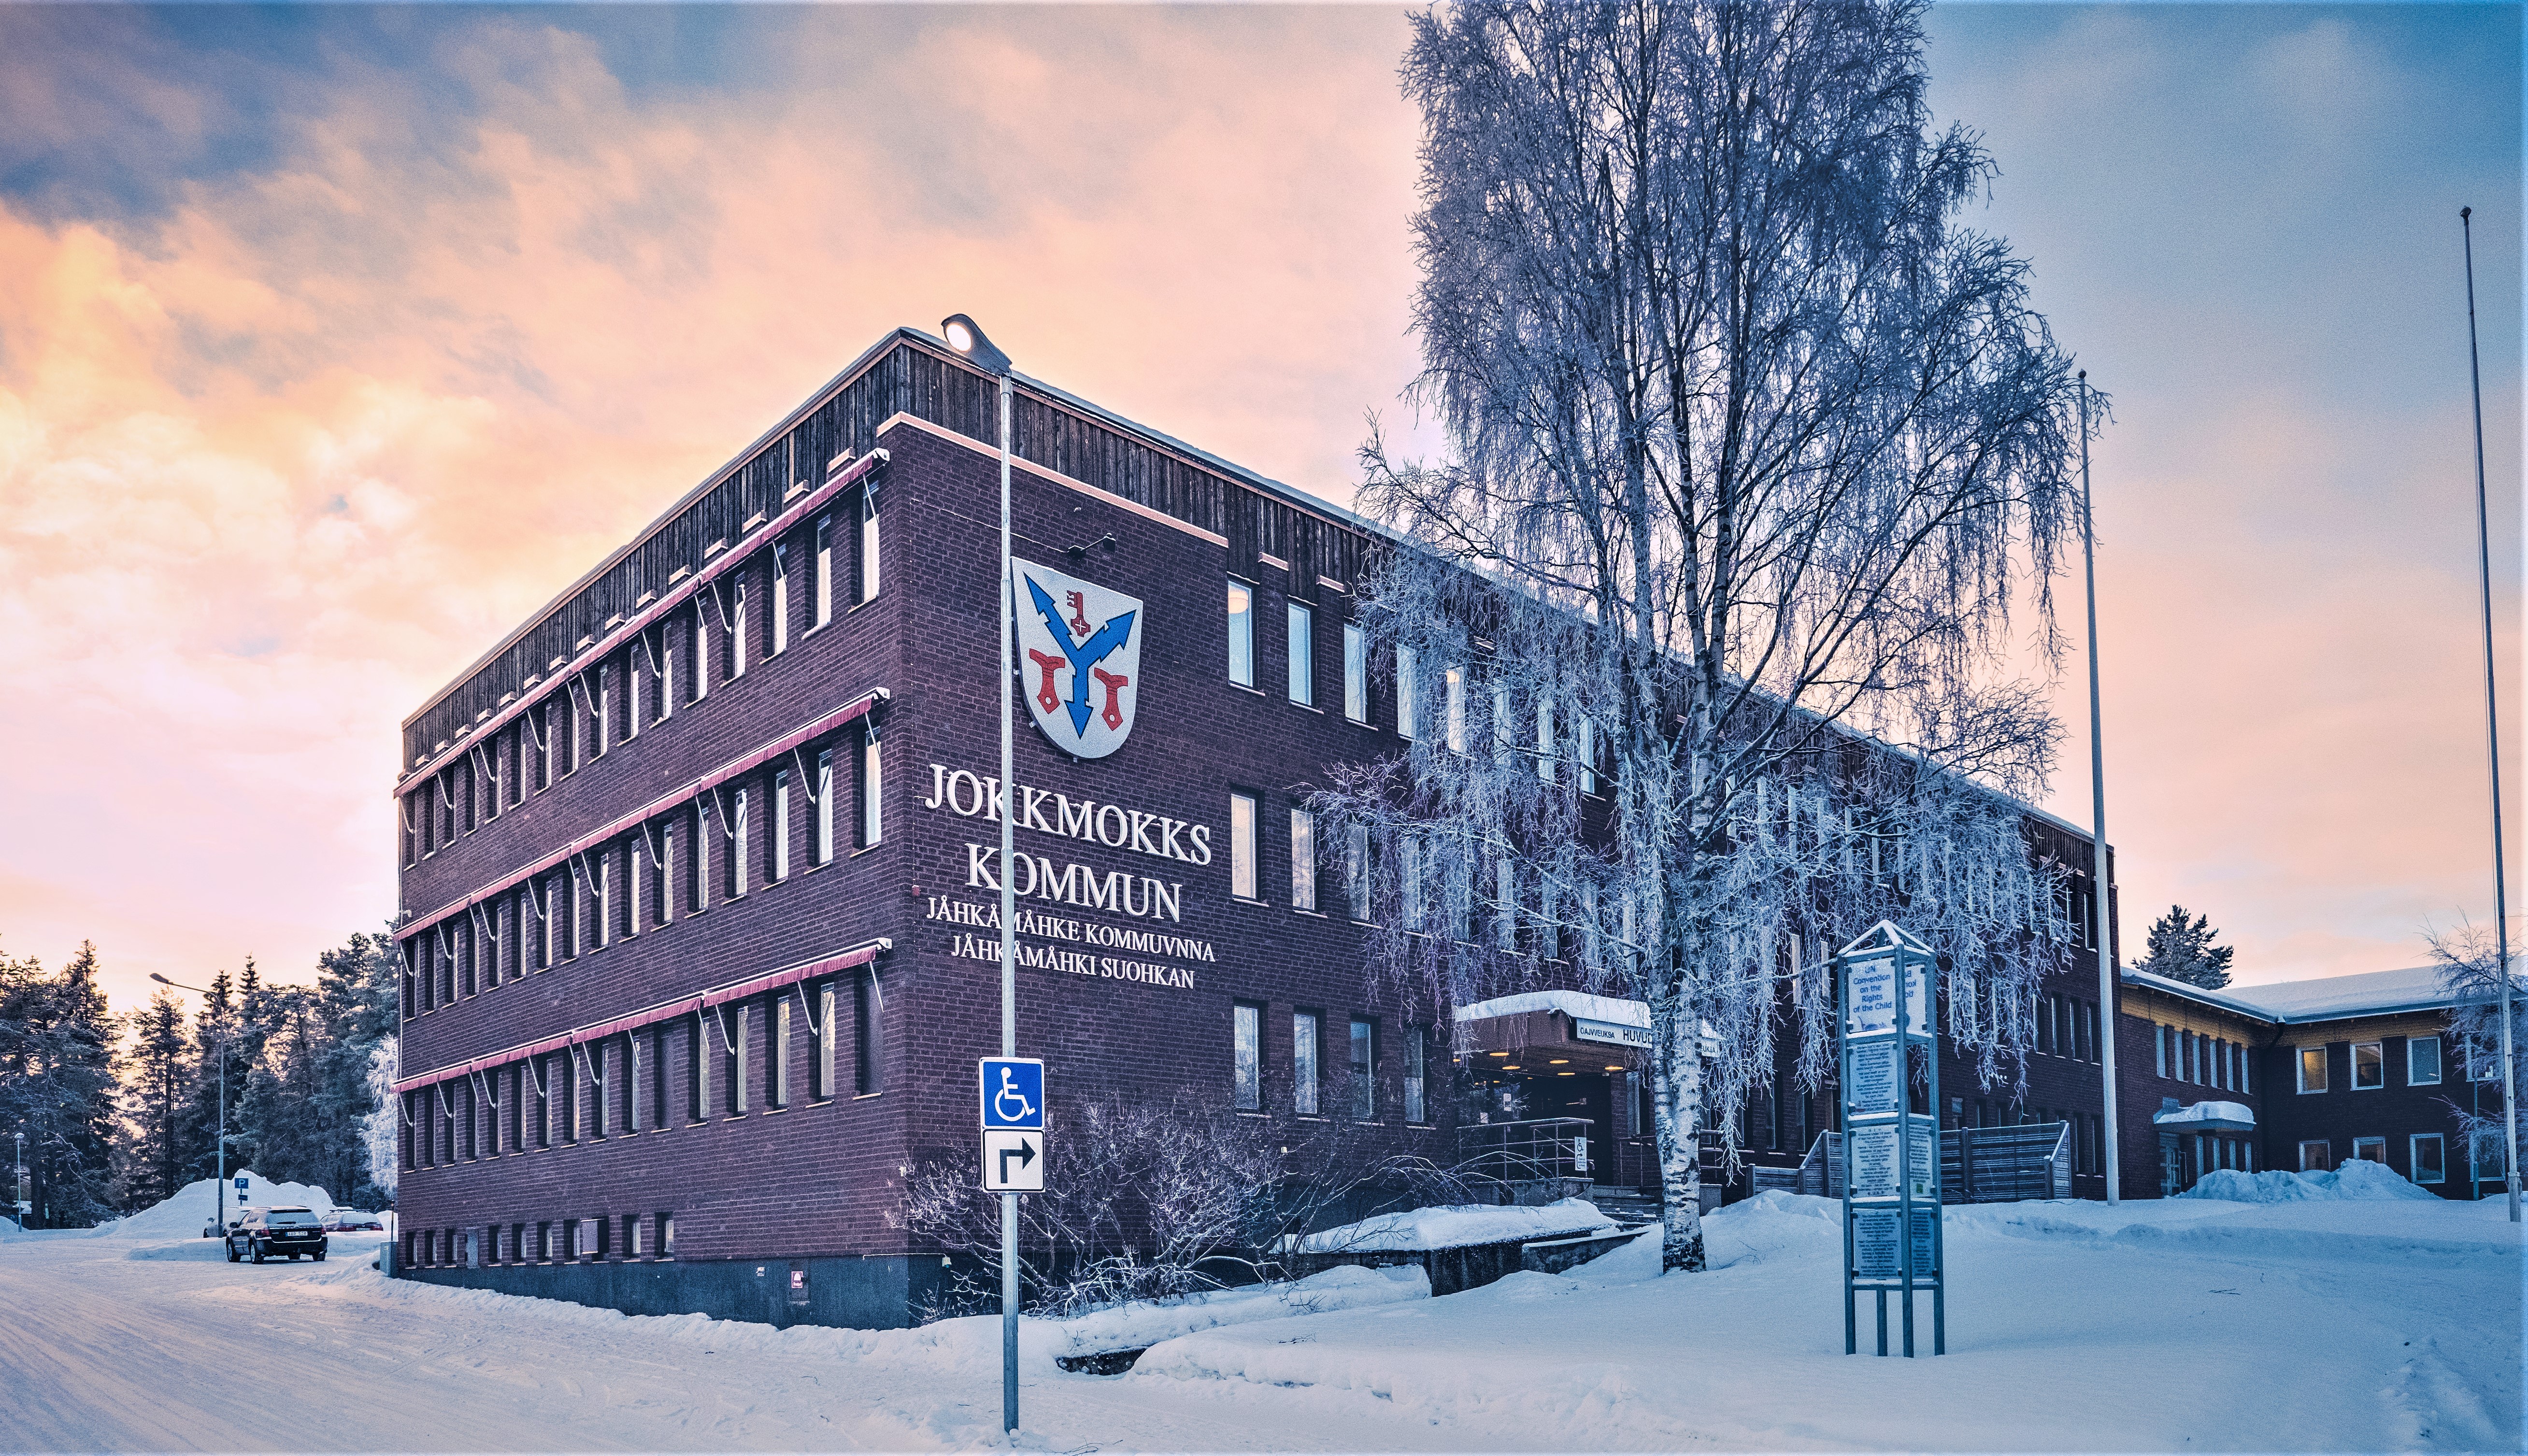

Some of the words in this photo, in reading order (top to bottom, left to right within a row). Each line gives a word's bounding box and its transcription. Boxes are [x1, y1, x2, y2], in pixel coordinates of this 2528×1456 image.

[925, 764, 1211, 865] JOKKMOKKS
[964, 843, 1183, 922] KOMMUN
[1085, 923, 1215, 962] KOMMUVNNA
[952, 933, 1097, 976] JÅHKÅMÅHKI
[1101, 958, 1194, 989] SUOHKAN
[1853, 974, 1890, 985] Convention
[1862, 994, 1883, 1003] Rights
[1875, 1001, 1892, 1010] Child
[239, 1179, 245, 1188] P
